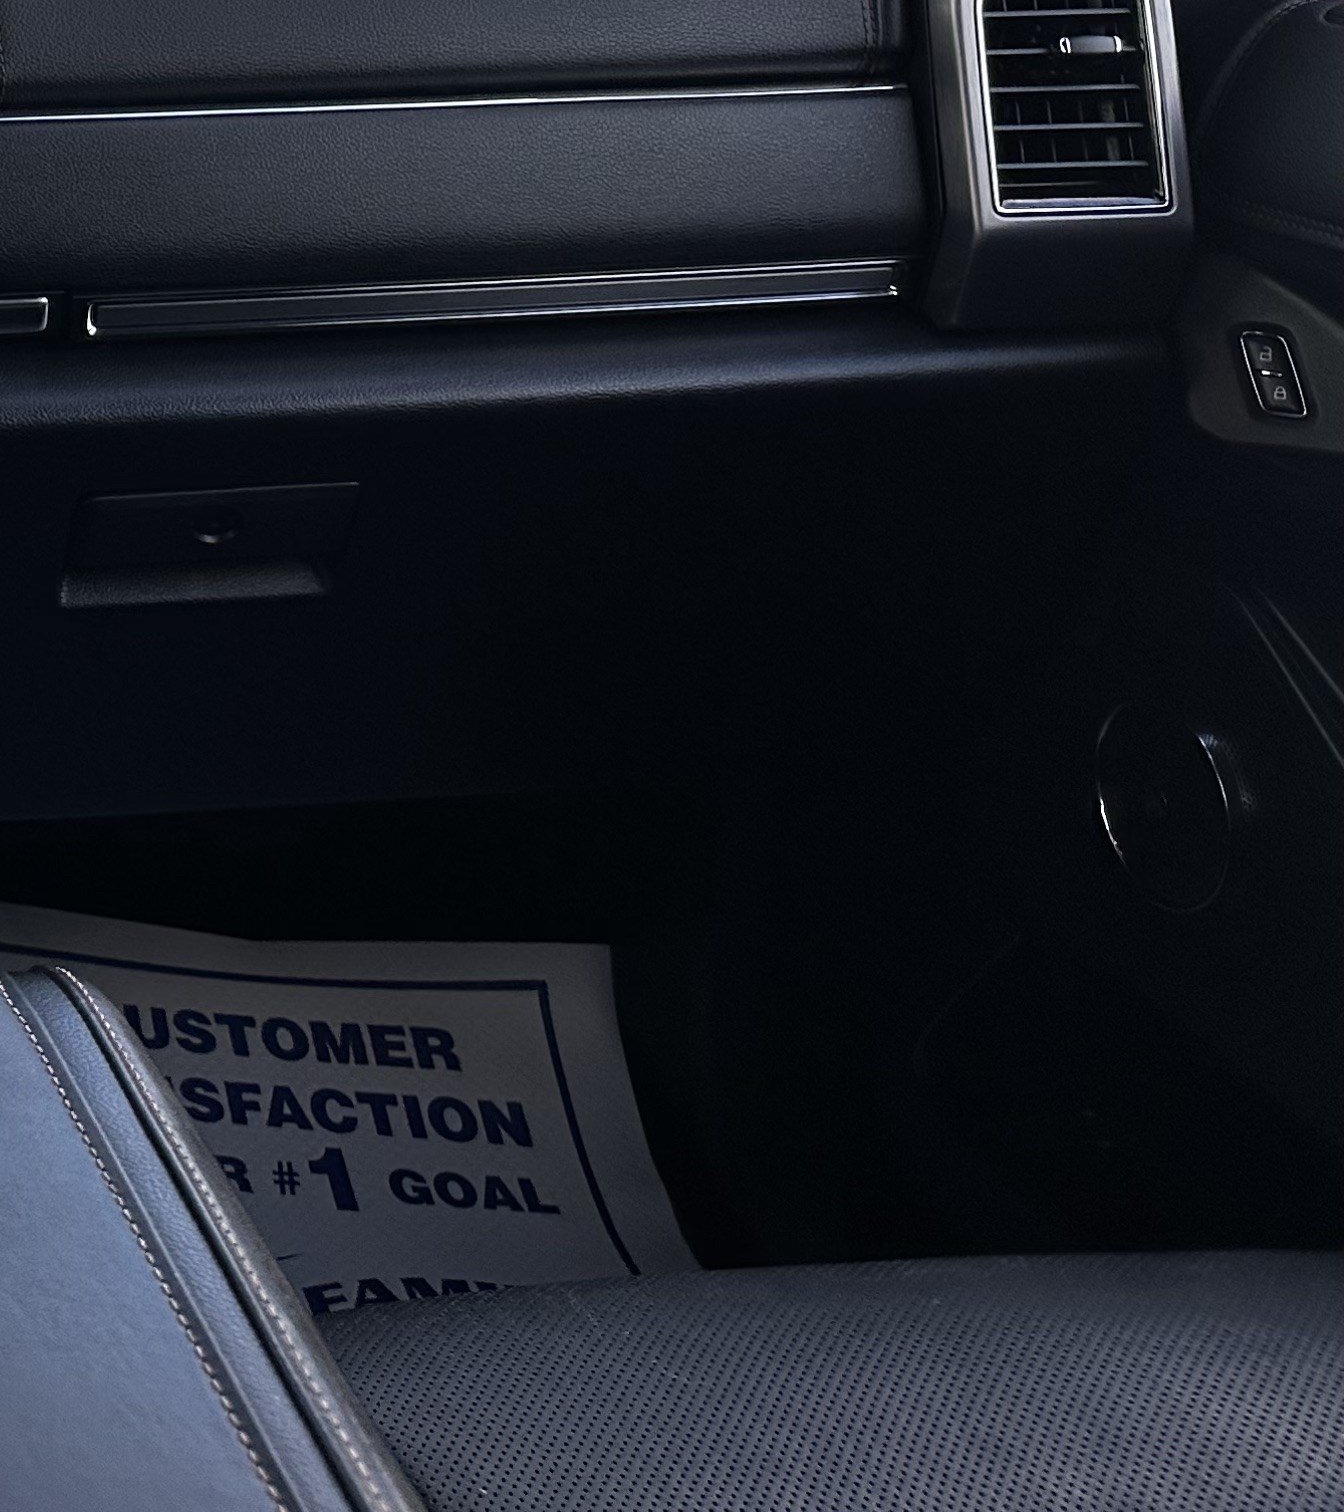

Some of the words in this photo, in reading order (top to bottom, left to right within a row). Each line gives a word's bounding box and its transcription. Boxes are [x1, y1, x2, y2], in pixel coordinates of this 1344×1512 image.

[123, 1004, 462, 1072] USTOMER
[165, 1076, 534, 1148] SFACTION
[388, 1168, 562, 1215] GOAL
